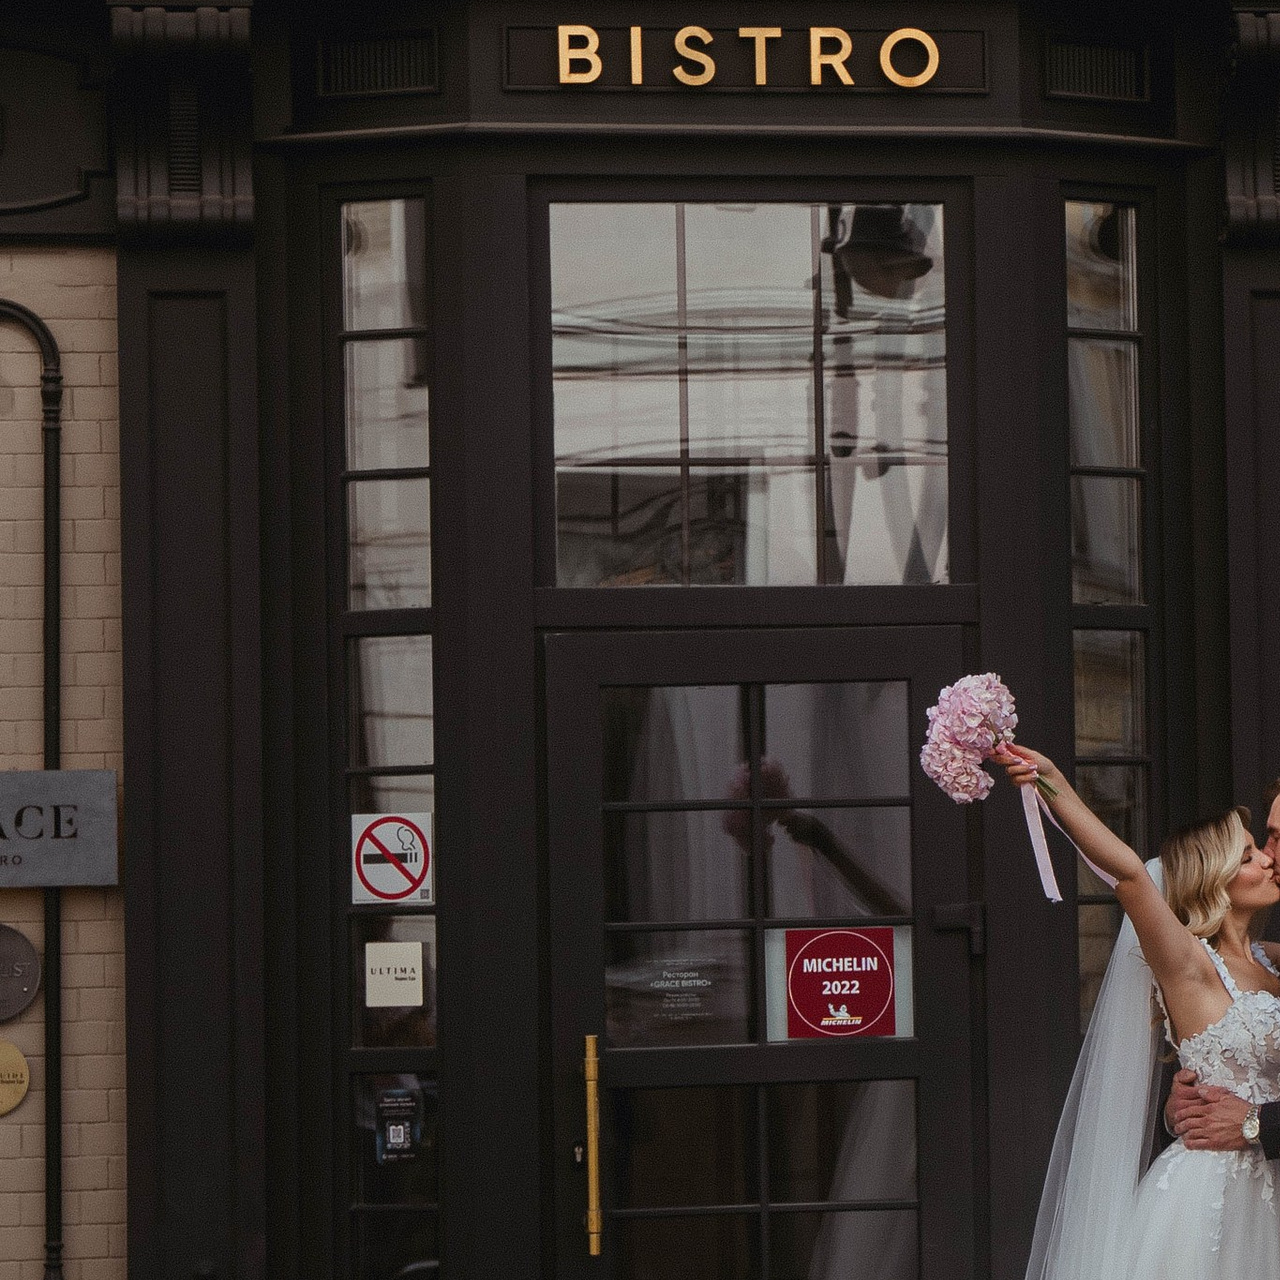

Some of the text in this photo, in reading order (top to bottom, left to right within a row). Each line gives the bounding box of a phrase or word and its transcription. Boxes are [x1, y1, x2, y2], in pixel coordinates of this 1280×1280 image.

[557, 24, 941, 88] BISTRO
[803, 956, 878, 973] MICHELIN
[370, 967, 416, 975] ULTIMA
[662, 971, 699, 980] Ресторан
[822, 980, 860, 995] 2022
[820, 1018, 862, 1026] MICHELIN
